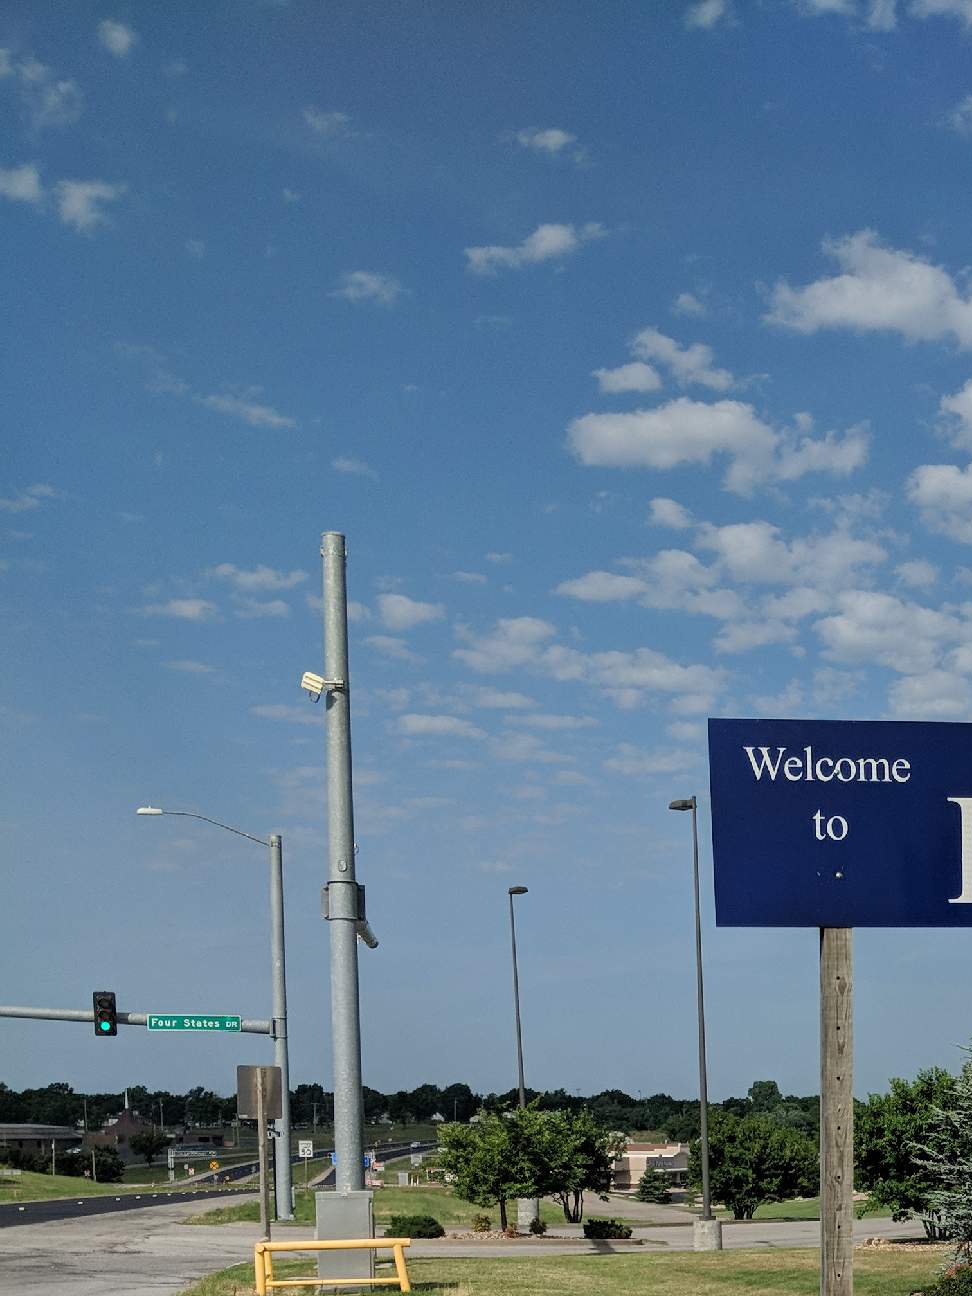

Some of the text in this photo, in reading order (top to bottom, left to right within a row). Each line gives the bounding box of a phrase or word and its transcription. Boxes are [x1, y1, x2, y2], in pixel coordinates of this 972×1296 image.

[743, 746, 911, 783] Welcome
[813, 809, 849, 841] to
[151, 1018, 177, 1027] Four
[183, 1018, 220, 1028] States
